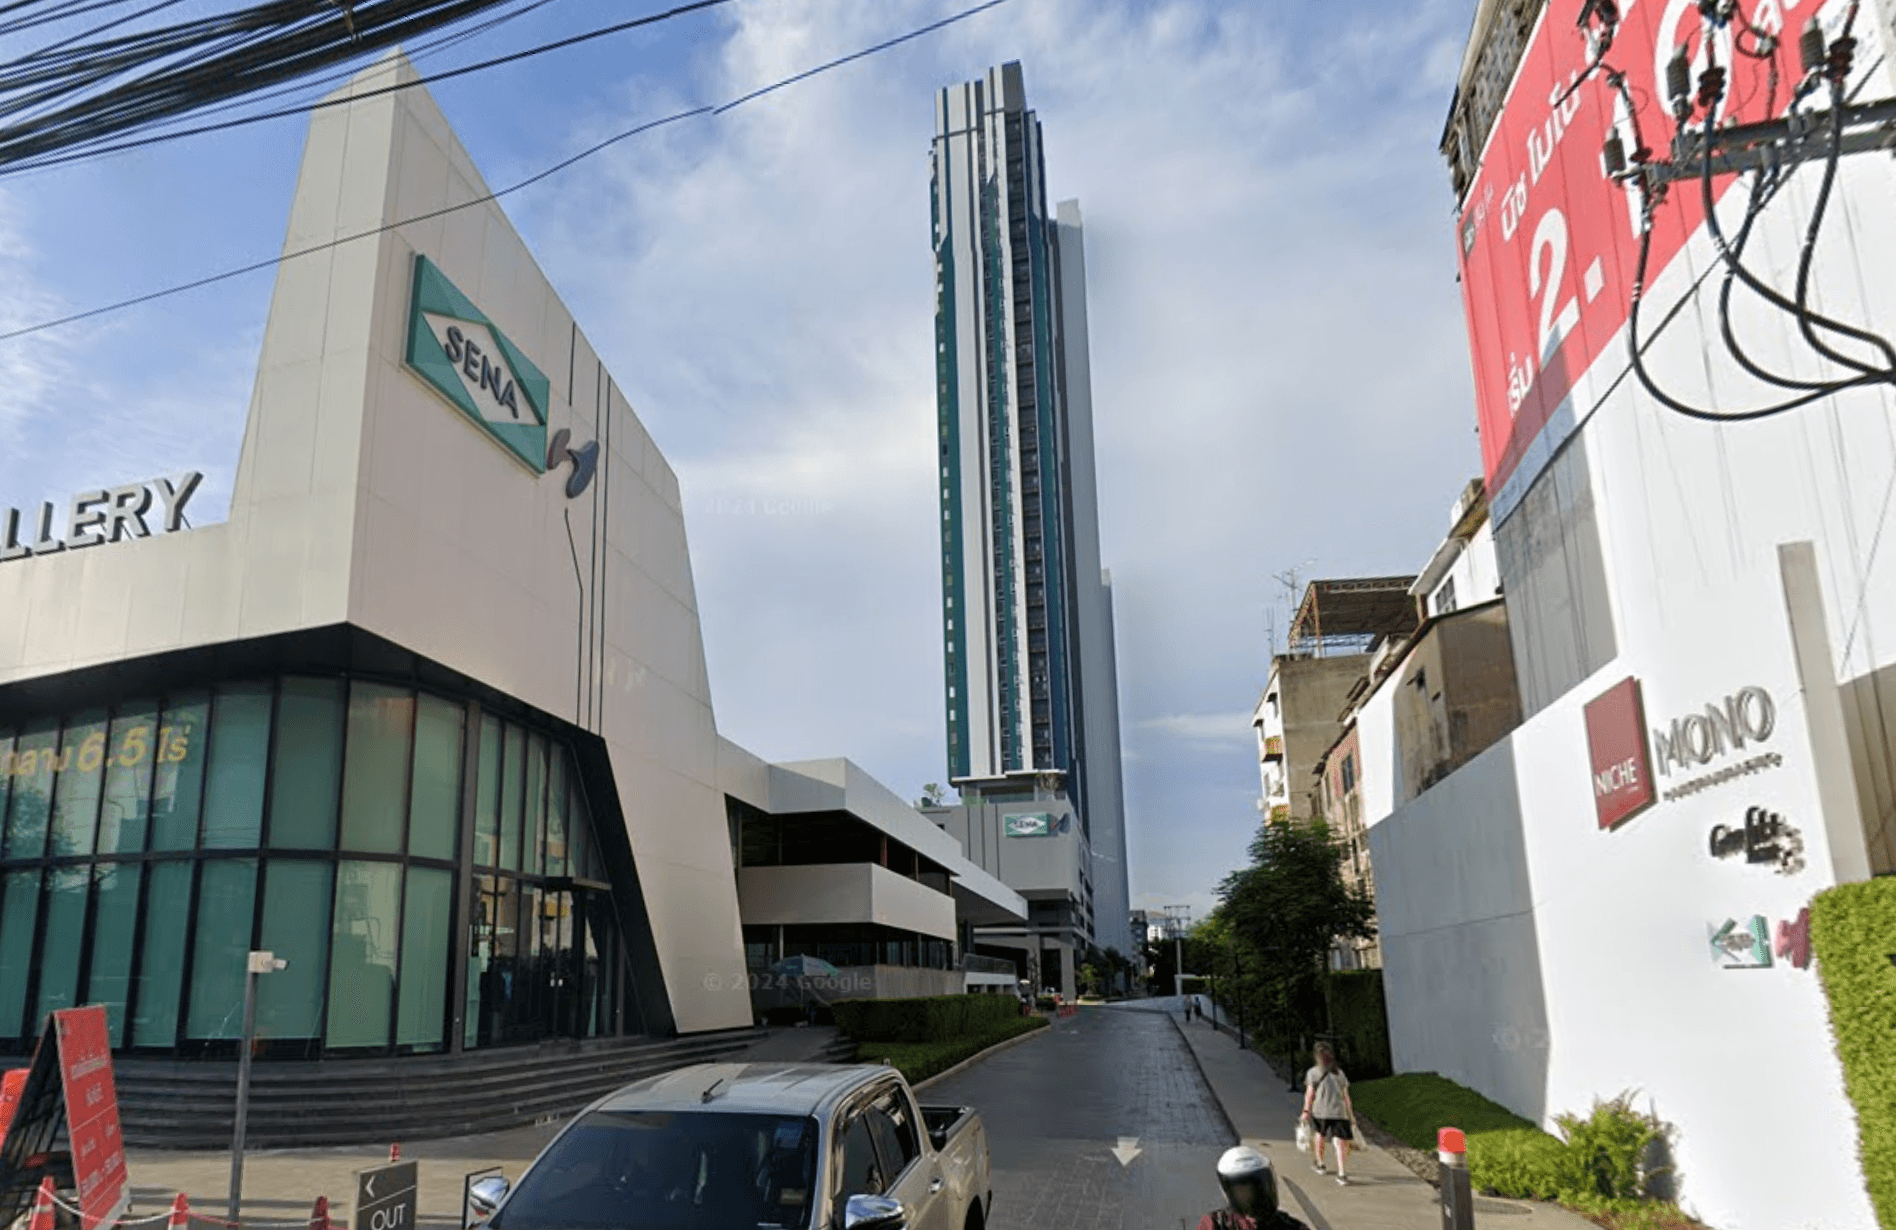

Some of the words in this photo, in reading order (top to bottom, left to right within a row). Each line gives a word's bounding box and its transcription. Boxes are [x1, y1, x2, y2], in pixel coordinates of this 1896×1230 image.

[445, 326, 519, 419] SENA
[77, 724, 147, 772] 6.5
[1653, 685, 1775, 777] MONO
[371, 1203, 406, 1230] OUT
